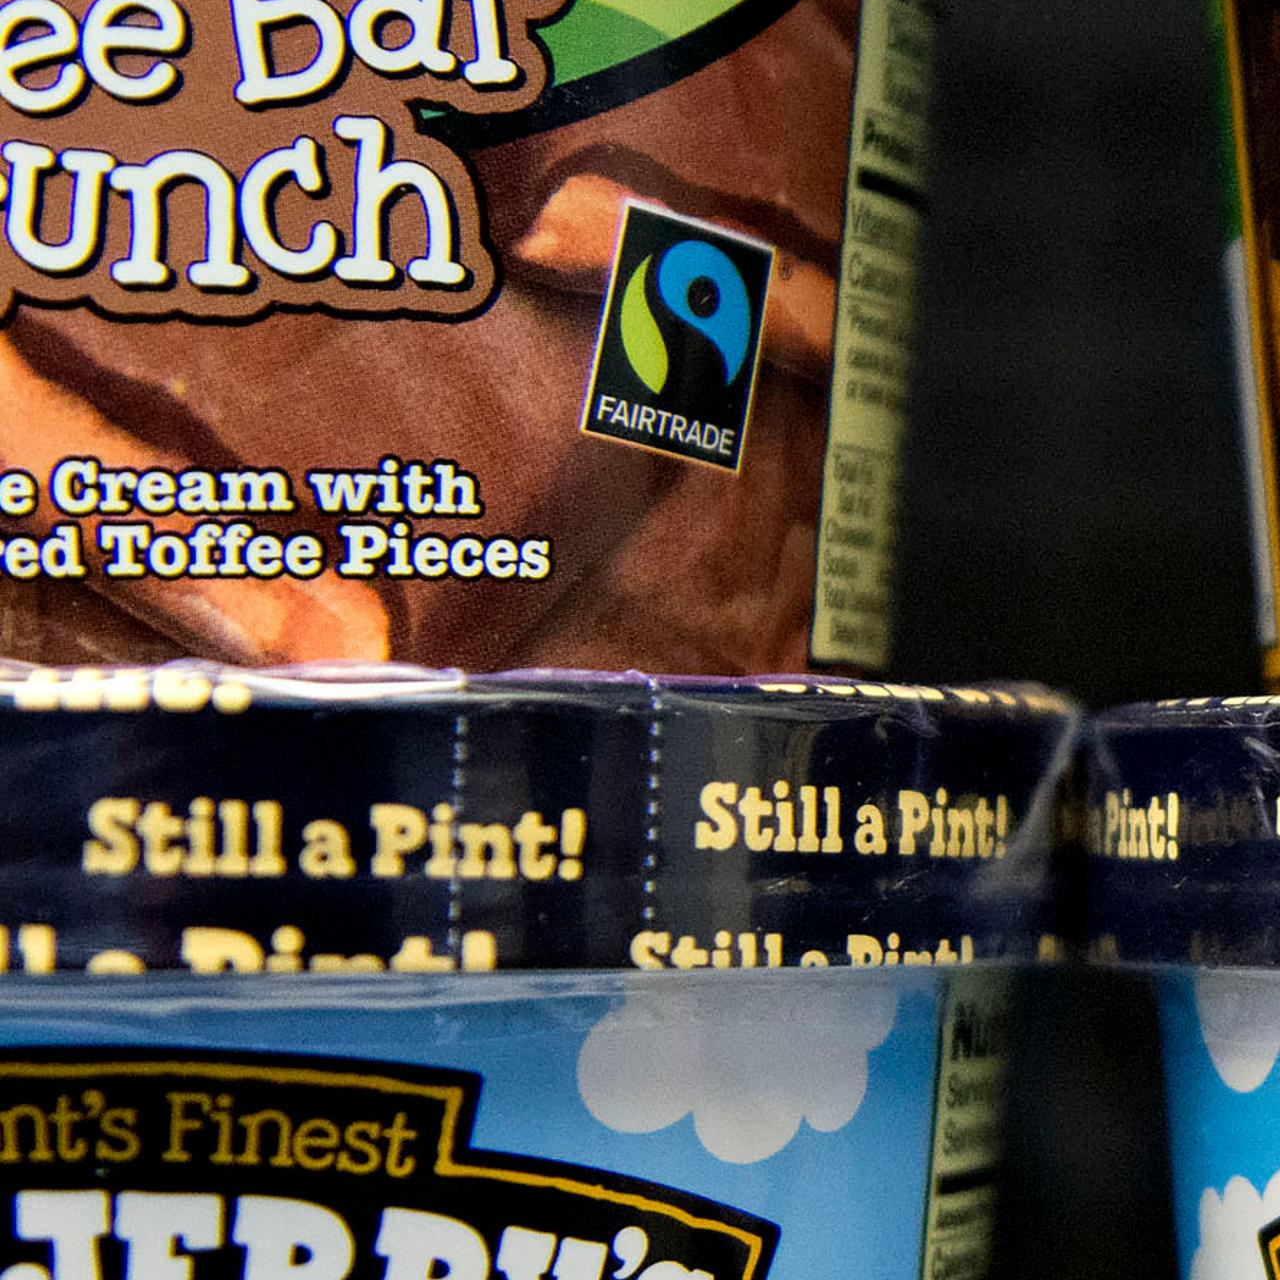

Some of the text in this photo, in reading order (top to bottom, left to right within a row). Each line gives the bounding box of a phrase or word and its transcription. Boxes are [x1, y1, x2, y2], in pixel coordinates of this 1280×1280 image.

[595, 394, 736, 457] FAIRTRADE
[50, 458, 482, 518] Cream with
[101, 524, 552, 579] Toffee Pieces
[82, 796, 587, 882] Still a Pint!
[694, 780, 1007, 861] Still a Pint!
[161, 1091, 418, 1177] Finest
